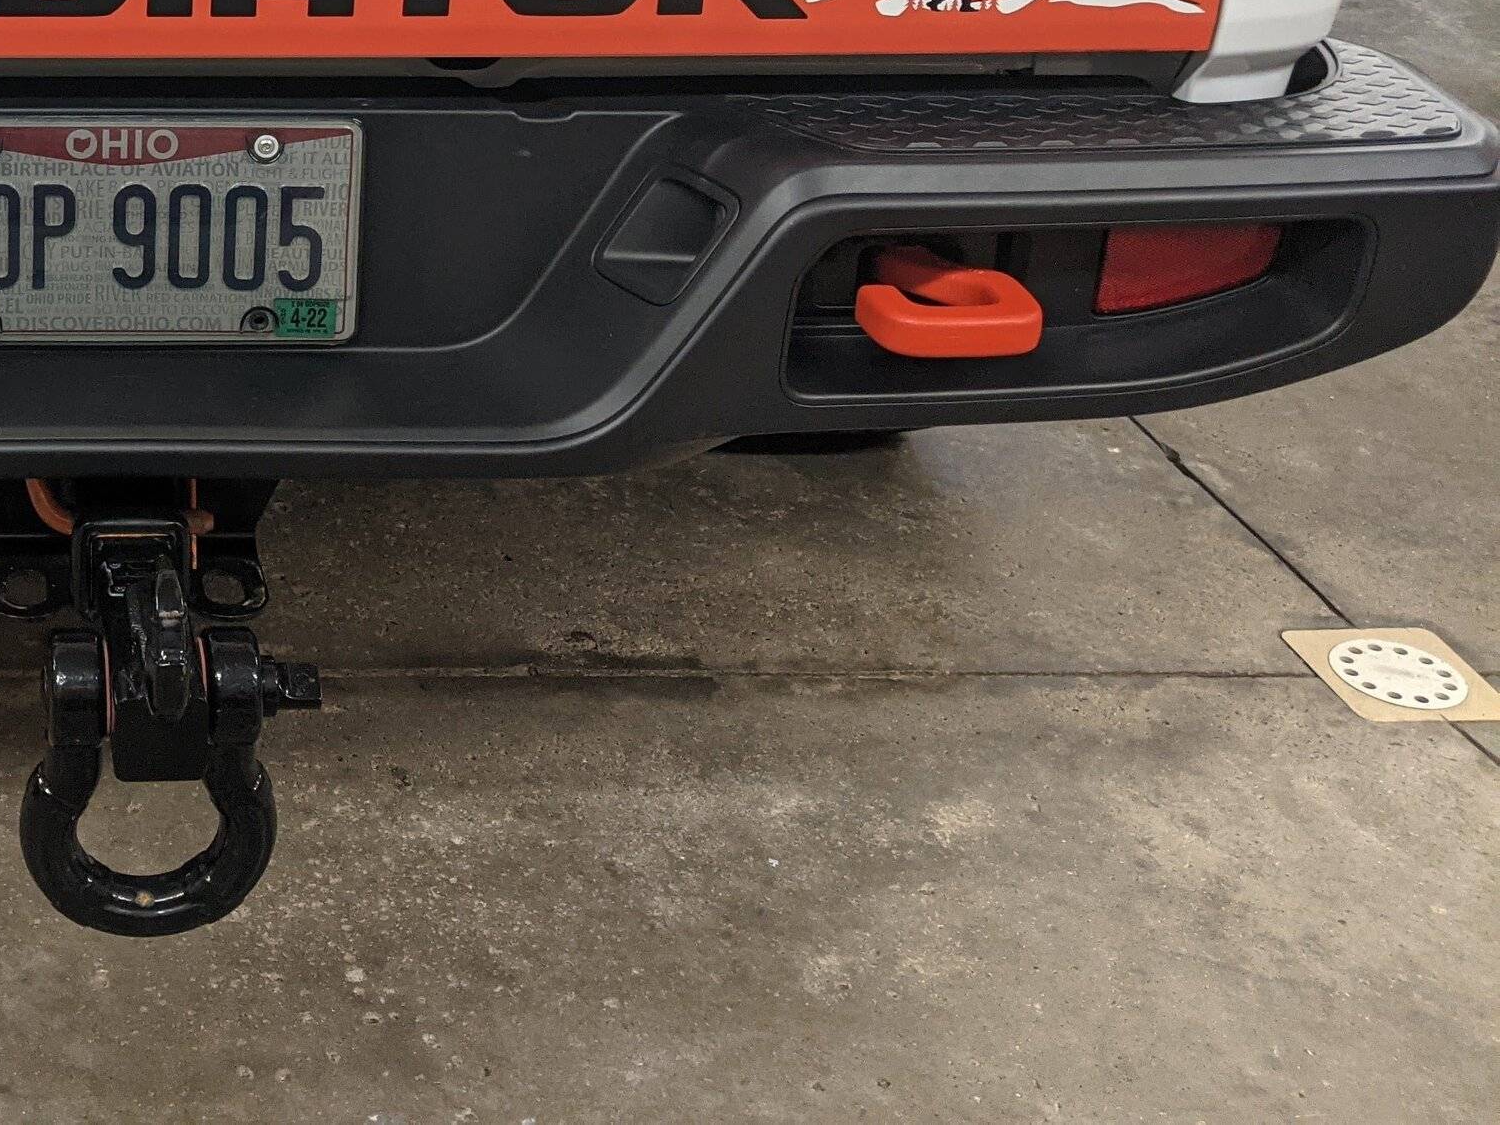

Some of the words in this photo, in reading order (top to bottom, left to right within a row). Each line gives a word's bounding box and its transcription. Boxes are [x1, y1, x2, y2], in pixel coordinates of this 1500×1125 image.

[65, 128, 179, 160] OHIO
[2, 162, 115, 176] BIRTHPLACE
[121, 163, 146, 176] OF
[151, 162, 239, 177] AVIATION
[112, 183, 325, 292] 9005
[290, 307, 328, 329] 4-22
